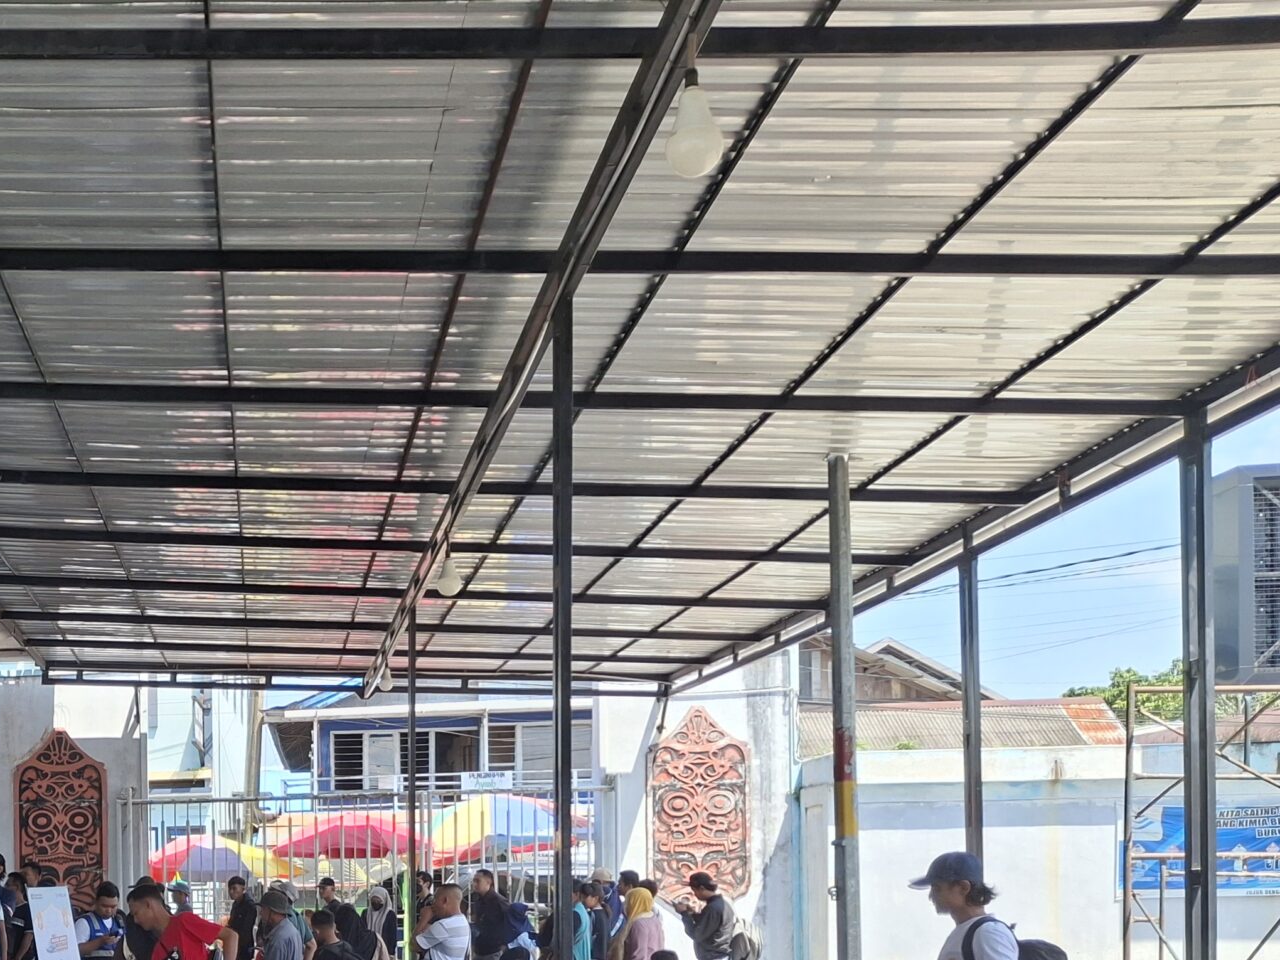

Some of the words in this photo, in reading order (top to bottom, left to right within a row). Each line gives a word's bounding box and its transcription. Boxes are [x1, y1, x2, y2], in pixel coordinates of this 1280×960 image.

[1218, 809, 1241, 818] KITA
[1243, 807, 1277, 817] SALING
[1239, 818, 1268, 828] KIMIA
